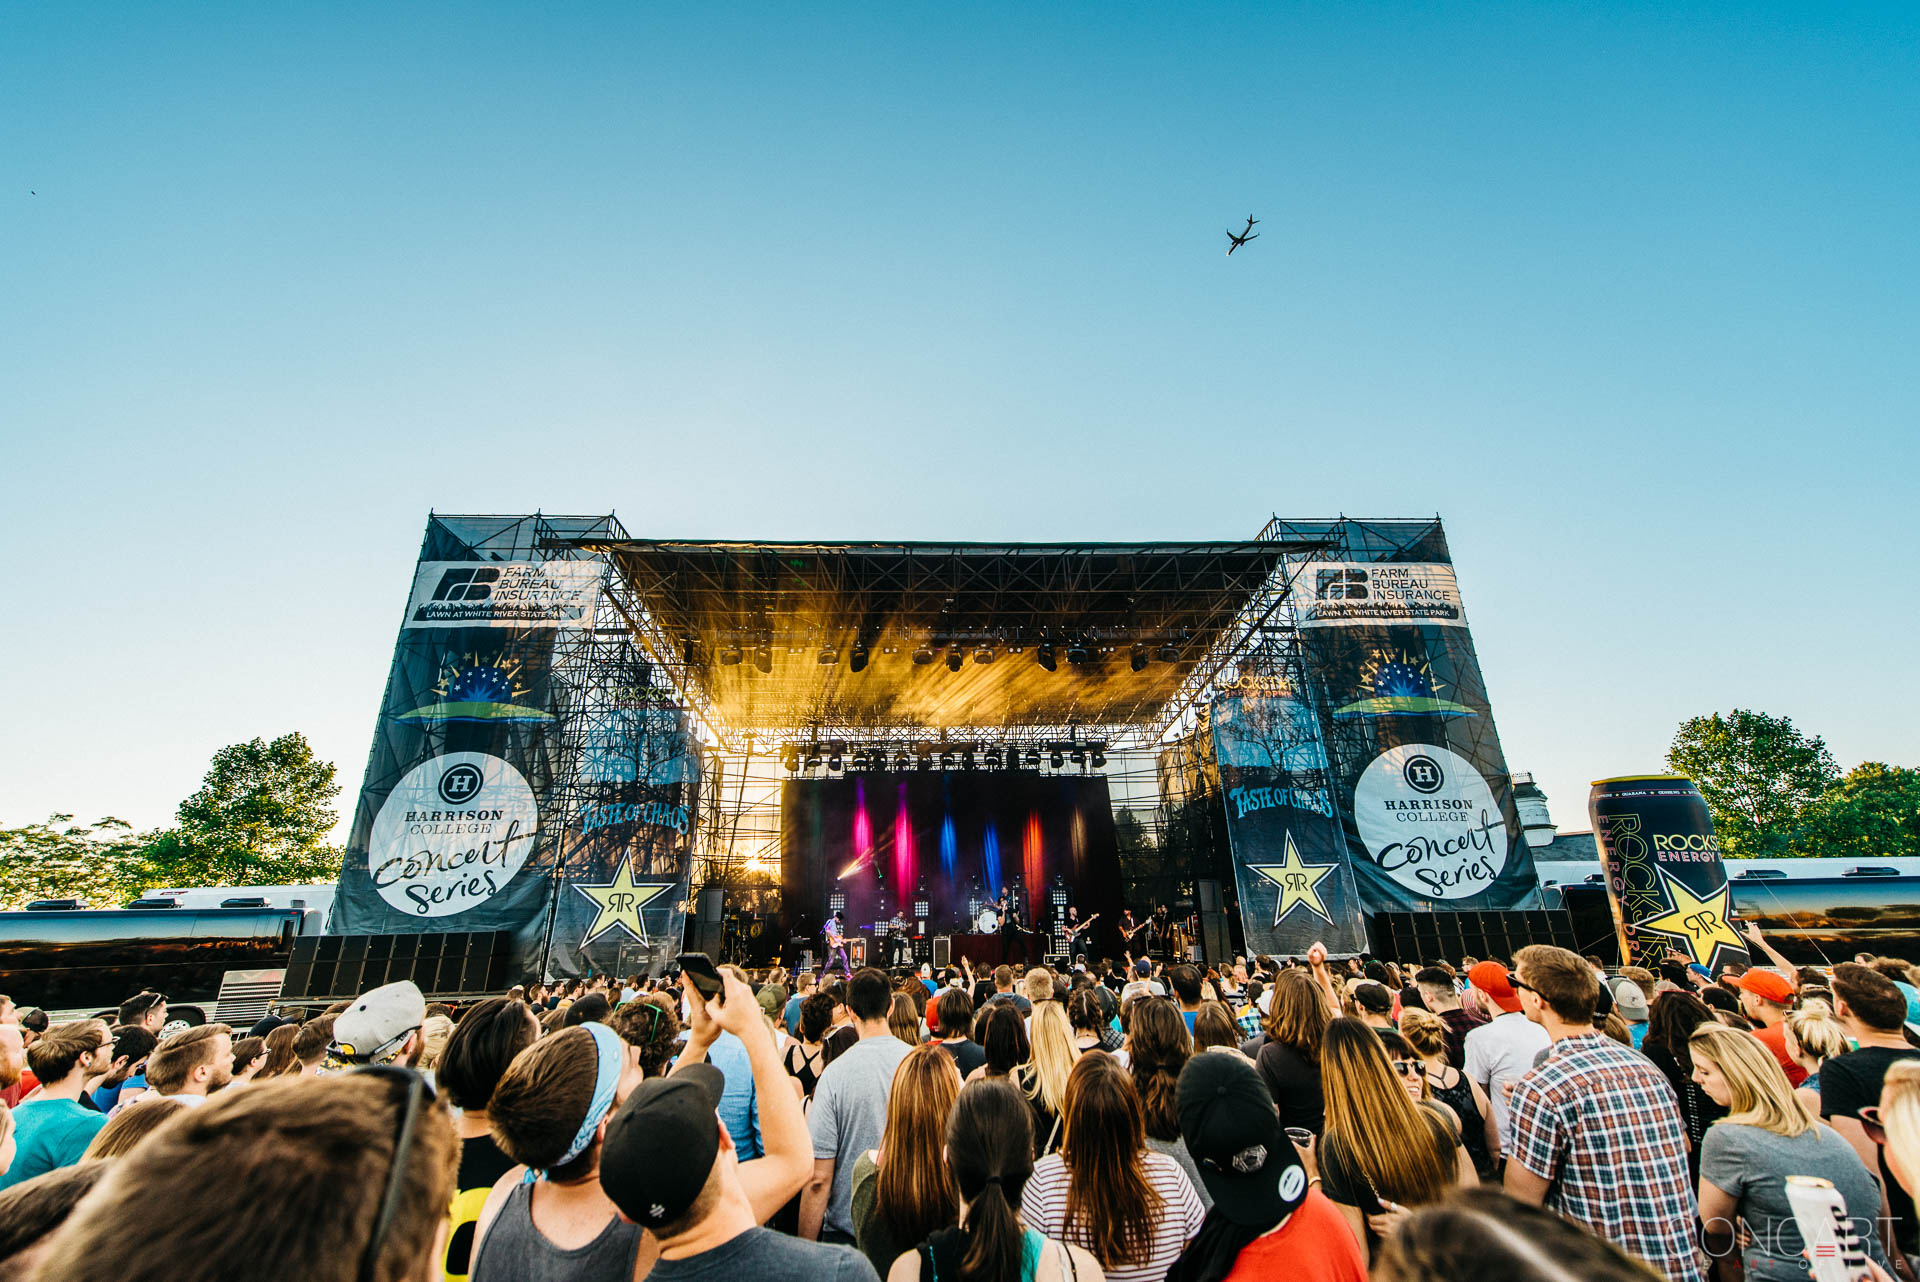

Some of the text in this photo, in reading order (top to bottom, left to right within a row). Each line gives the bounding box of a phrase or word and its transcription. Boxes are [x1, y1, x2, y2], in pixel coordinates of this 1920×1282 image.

[504, 567, 546, 578] FARM
[1371, 569, 1409, 579] FARM
[499, 579, 563, 589] BUREAU
[1372, 580, 1429, 589] BUREAU
[494, 590, 583, 601] INSURANCE
[1373, 590, 1451, 601] INSURANCE
[1229, 784, 1276, 818] TASTE
[1274, 788, 1289, 806] OF
[1384, 799, 1473, 810] HARRISON
[404, 810, 504, 822] HARRISON
[643, 802, 691, 835] CHAOS
[1396, 812, 1469, 822] COLLEGE
[410, 823, 492, 835] COLLEGE
[1652, 834, 1719, 851] ROCKS
[1598, 815, 1630, 907] ENERGY
[1657, 851, 1715, 862] ENERGY
